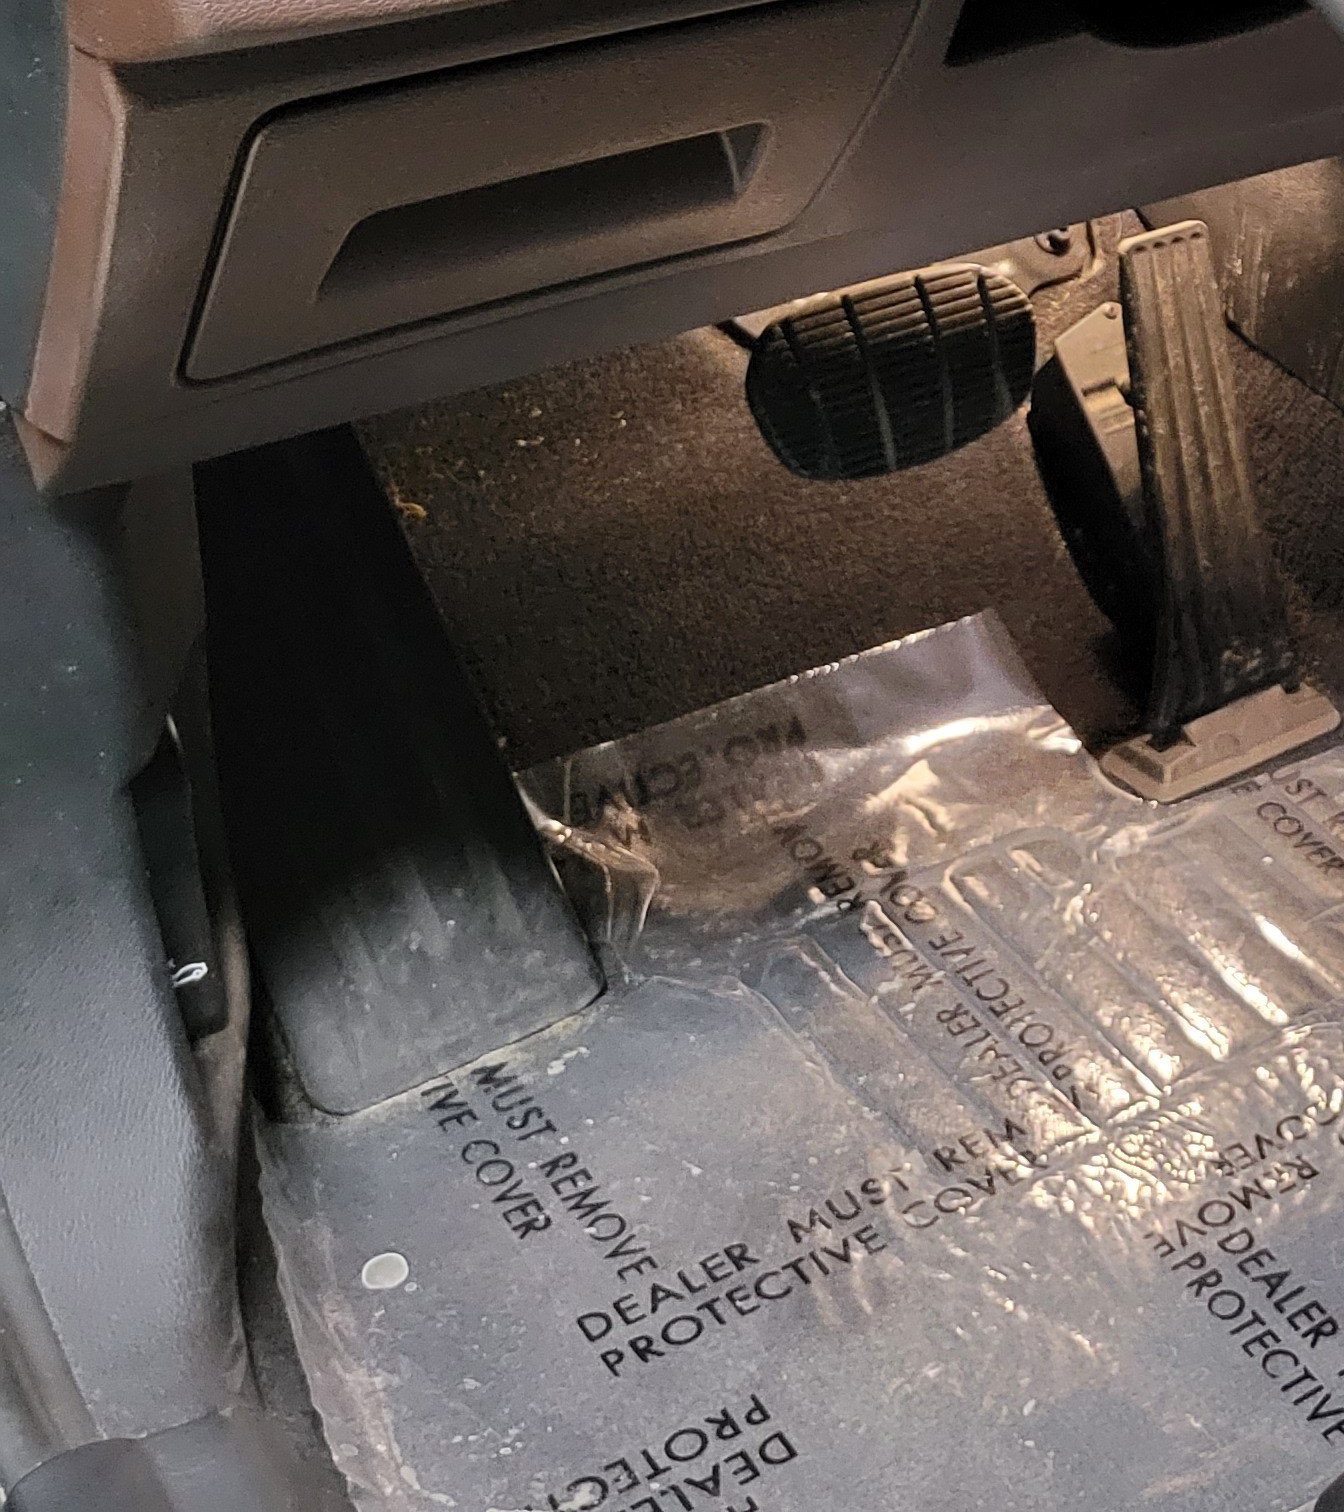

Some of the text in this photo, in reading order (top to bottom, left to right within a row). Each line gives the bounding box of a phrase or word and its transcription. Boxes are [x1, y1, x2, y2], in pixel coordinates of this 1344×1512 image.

[460, 1138, 553, 1240] COVER
[470, 1061, 658, 1285] MUST REMOVE
[1143, 1154, 1320, 1258] REMOVE
[575, 1241, 761, 1343] DEALER
[786, 1167, 910, 1244] MUST
[599, 1224, 889, 1378] PROTECTIVE
[1216, 1226, 1340, 1349] DEALER
